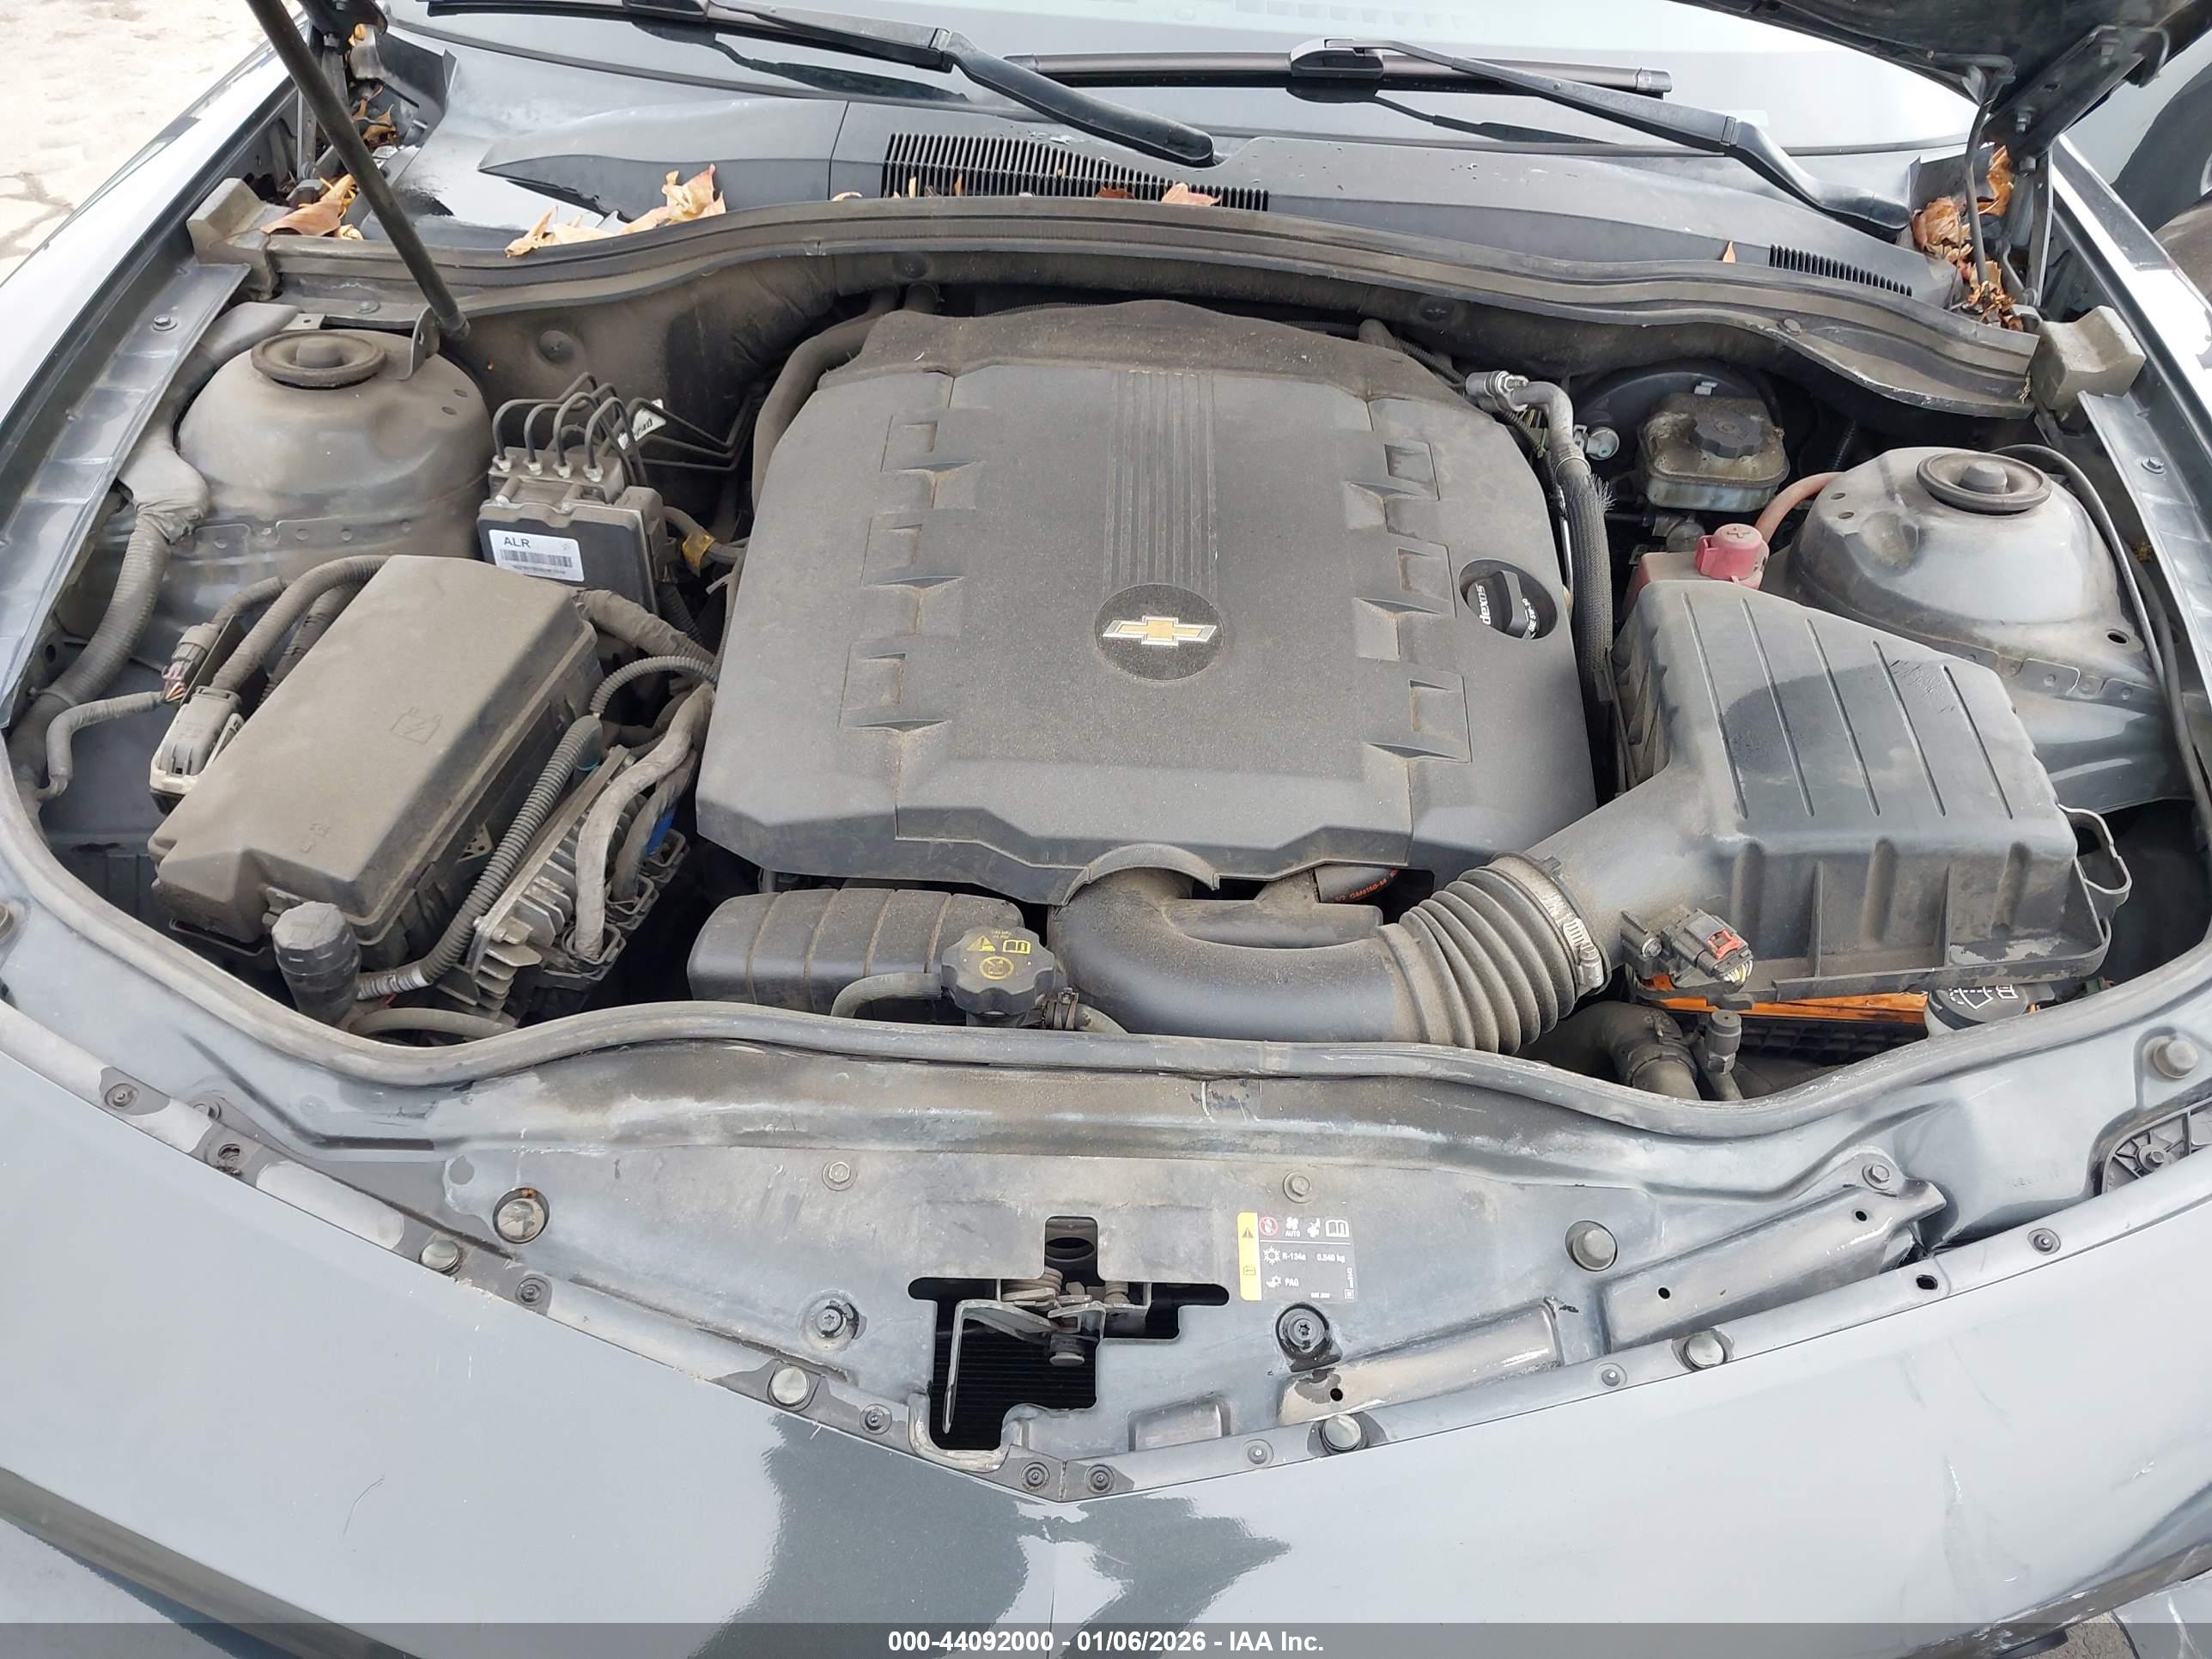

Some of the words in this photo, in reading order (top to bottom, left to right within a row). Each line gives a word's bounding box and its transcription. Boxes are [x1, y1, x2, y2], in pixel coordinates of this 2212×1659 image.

[504, 537, 531, 549] ALR
[1475, 583, 1492, 625] dexos
[1282, 1252, 1306, 1261] R-134a
[1336, 1254, 1346, 1263] kg
